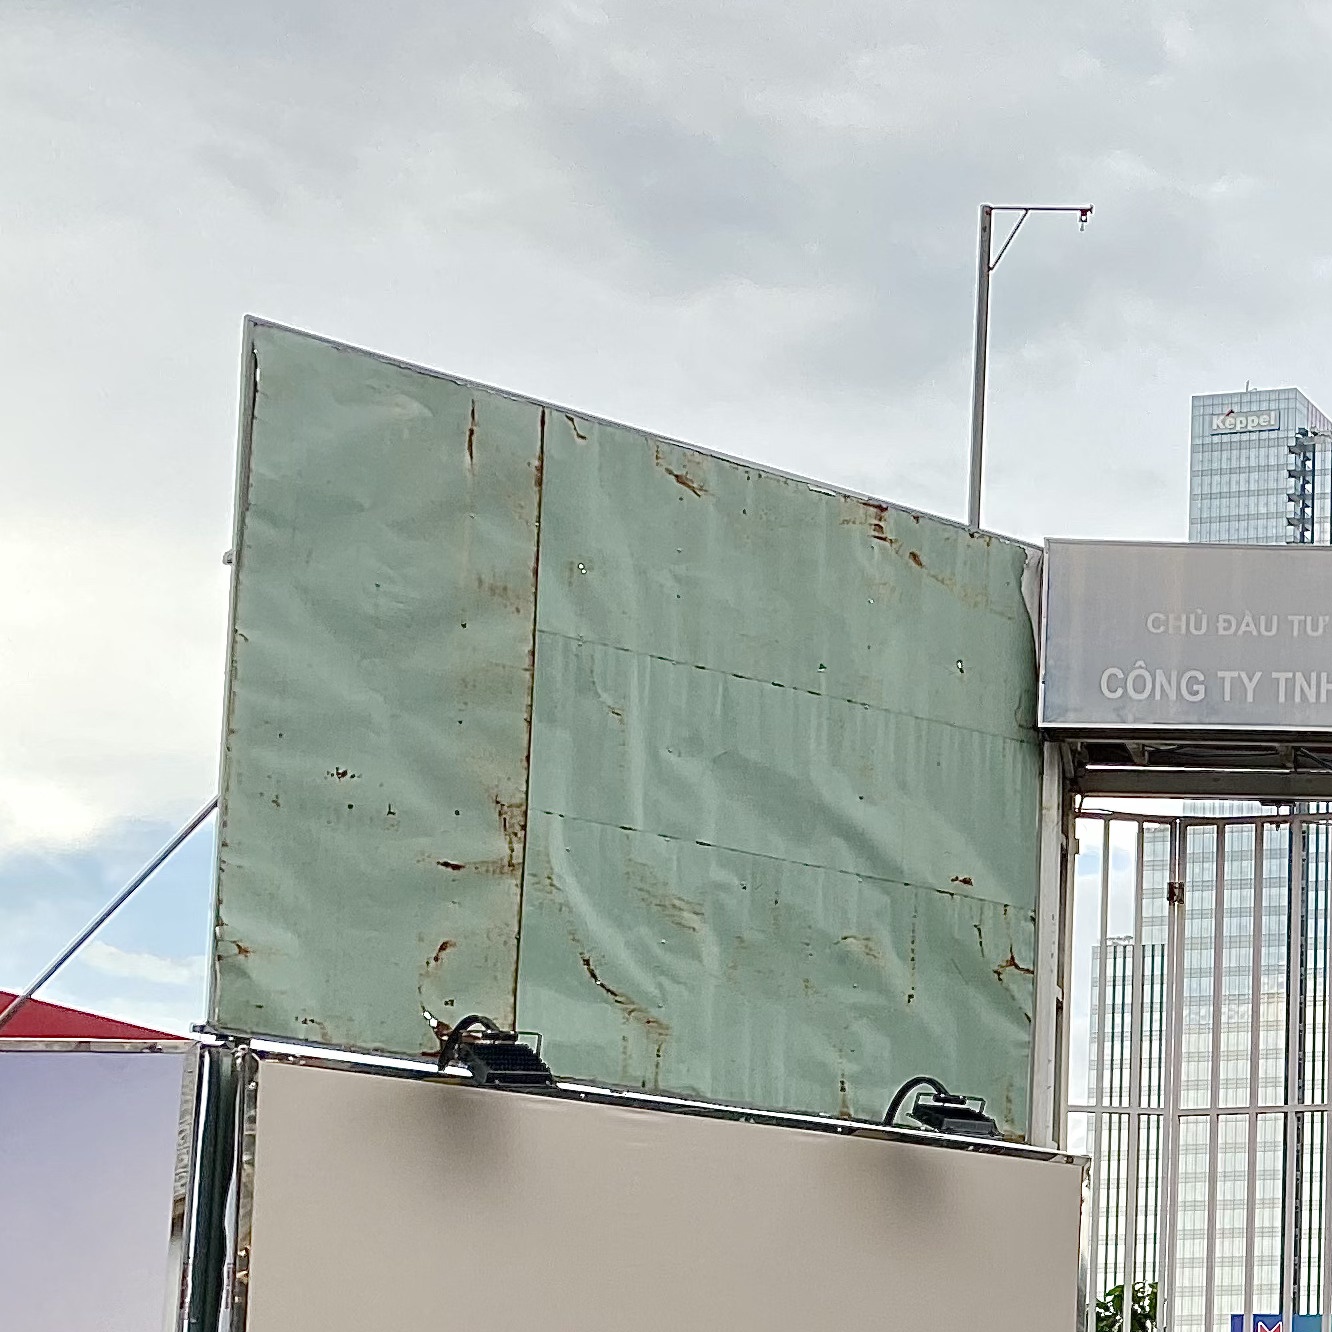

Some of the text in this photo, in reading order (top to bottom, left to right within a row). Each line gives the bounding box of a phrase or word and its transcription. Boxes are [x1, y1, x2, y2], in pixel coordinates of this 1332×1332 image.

[1212, 410, 1276, 431] Keppel
[1287, 615, 1331, 638] TƯ
[1100, 660, 1207, 702] CÔNG
[1217, 670, 1265, 702] TY
